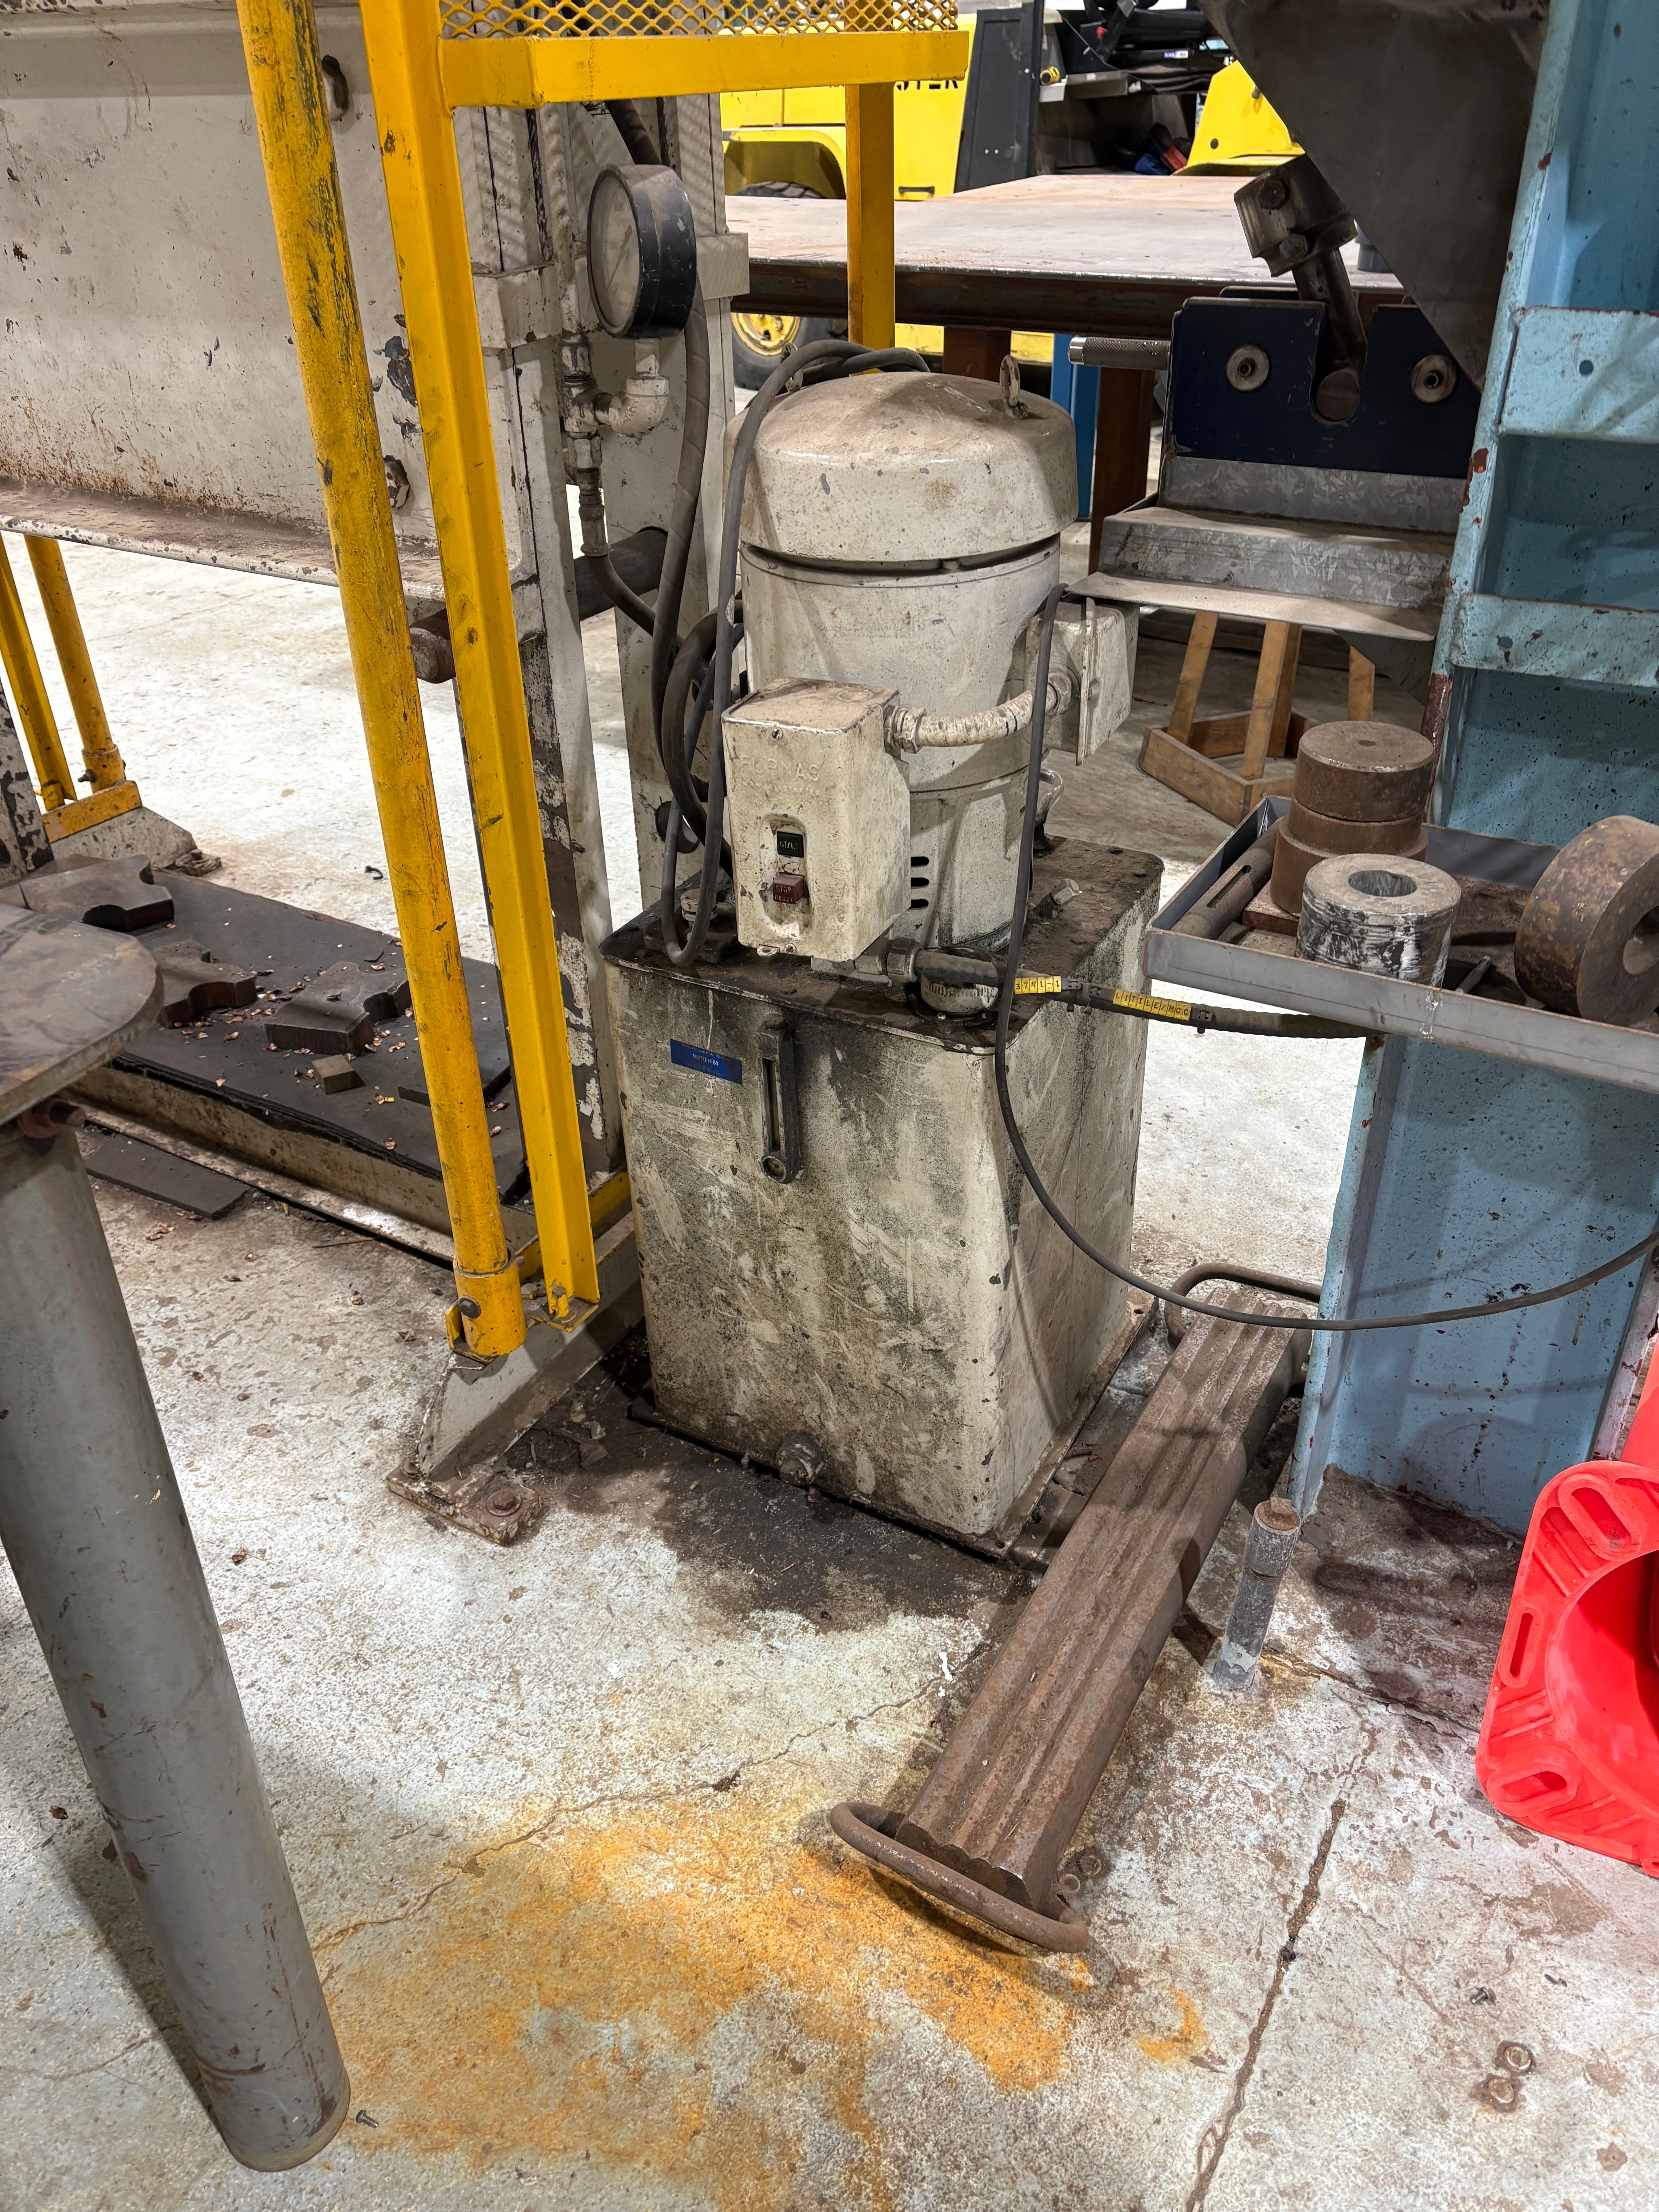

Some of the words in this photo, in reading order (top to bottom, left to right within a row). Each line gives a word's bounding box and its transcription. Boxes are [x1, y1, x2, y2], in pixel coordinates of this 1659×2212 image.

[741, 755, 819, 781] FURNAS
[776, 885, 792, 894] STOP
[775, 894, 793, 902] RESET
[1016, 979, 1060, 990] 37N1-1
[1115, 992, 1188, 1015] LITTLE/MCC
[692, 1053, 707, 1062] NUTO
